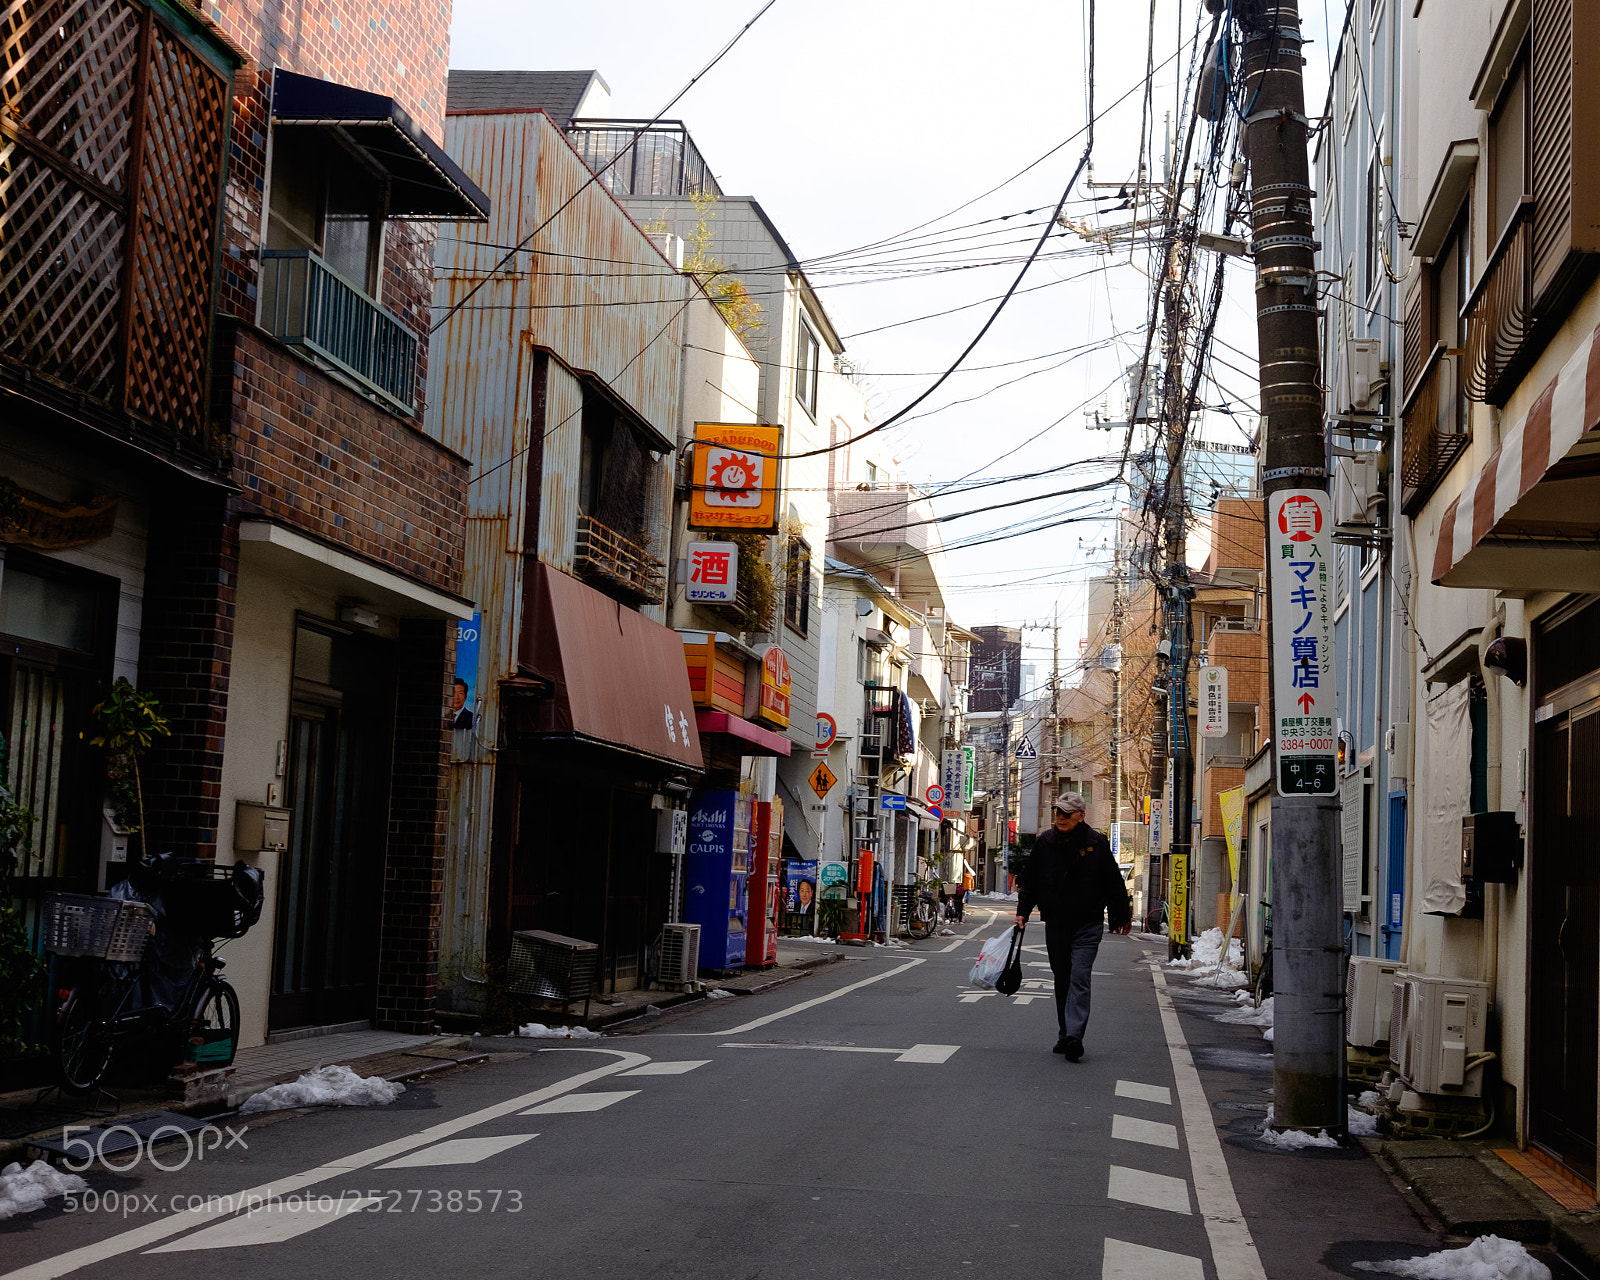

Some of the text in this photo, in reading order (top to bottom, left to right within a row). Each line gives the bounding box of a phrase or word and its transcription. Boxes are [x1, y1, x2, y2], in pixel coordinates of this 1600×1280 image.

[694, 511, 769, 524] ヤマザキショップ
[1281, 501, 1320, 539] 質
[690, 551, 730, 584] 酒
[690, 590, 727, 599] キリンビール
[1319, 562, 1330, 674] 品物によるキャッシング
[1289, 562, 1320, 688] マキノ質店
[1281, 727, 1333, 737] 中央3-33-4
[1281, 739, 1333, 750] 3384-0007
[1290, 764, 1326, 775] 中央
[1296, 778, 1321, 789] 4-6
[930, 790, 940, 799] 30
[691, 808, 727, 823] Asahi
[689, 843, 725, 854] CALPIS
